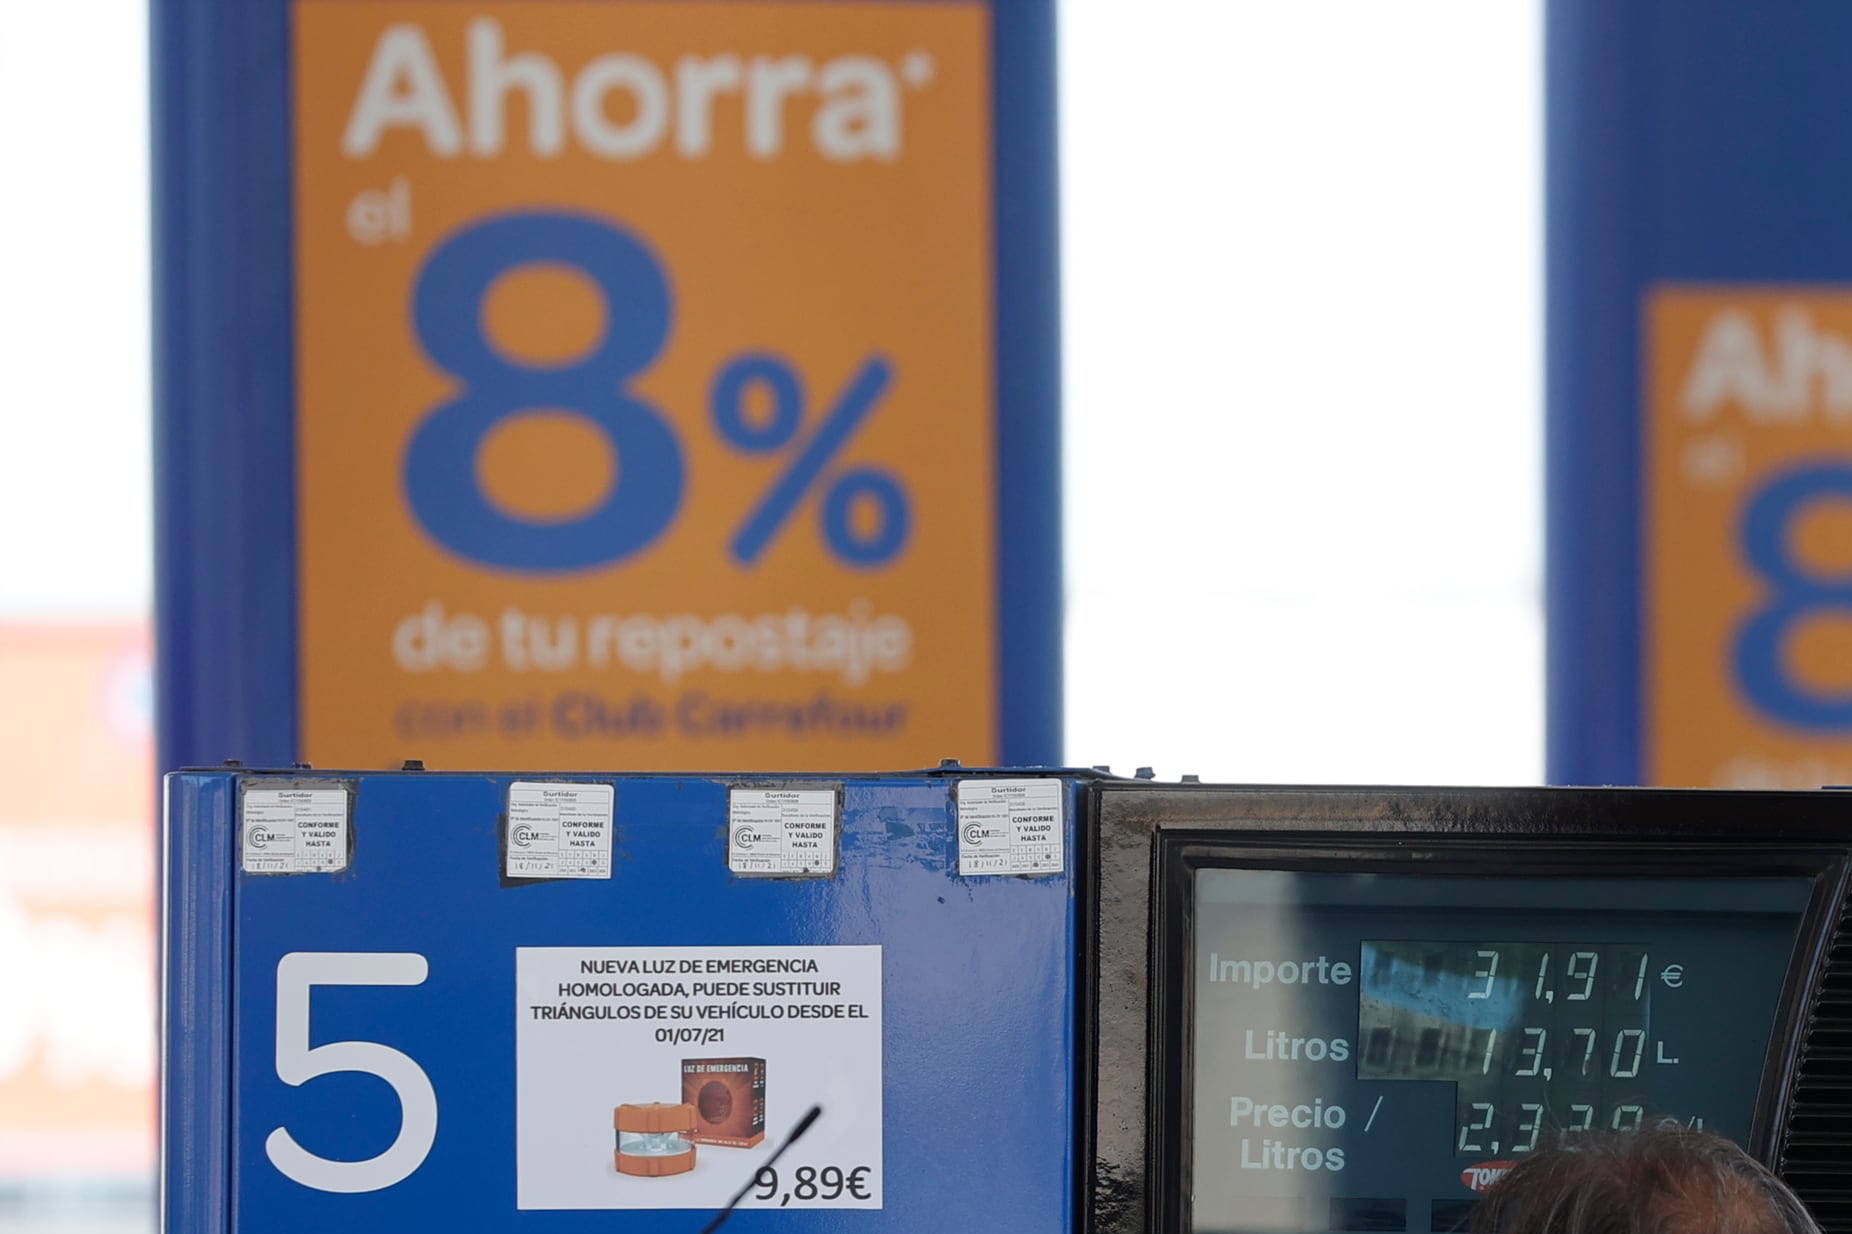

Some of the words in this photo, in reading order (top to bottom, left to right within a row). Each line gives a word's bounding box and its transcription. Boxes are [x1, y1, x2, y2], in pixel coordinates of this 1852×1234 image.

[346, 178, 412, 244] el
[392, 600, 489, 672] de
[501, 605, 579, 672] tu
[589, 598, 913, 688] repostaje
[552, 690, 664, 740] Club
[676, 690, 908, 741] Carrefour
[297, 821, 340, 829] CONFORME
[562, 821, 604, 829] CONFORME
[1012, 815, 1055, 824] CONFORME
[1023, 824, 1052, 832] VALIDO
[255, 833, 276, 842] CLM
[519, 832, 540, 841] CLM
[741, 834, 761, 842] CLM
[970, 829, 990, 838] CLM
[580, 959, 640, 974] NUEVA
[643, 959, 676, 974] LUZ
[679, 959, 703, 974] DE
[706, 959, 819, 974] EMERGENCIA
[1209, 952, 1352, 990] Importe
[1467, 950, 1649, 1004] 31,91
[1660, 963, 1684, 988] €
[558, 982, 690, 1000] HOMOLOGADA,
[693, 981, 750, 997] PUEDE
[753, 981, 841, 997] SUSTITUIR
[530, 1001, 641, 1020] TRIÁNGULOS
[644, 1005, 667, 1019] DE
[670, 1005, 693, 1019] SU
[696, 1000, 784, 1019] VEHÍCULO
[788, 1004, 844, 1019] DESDE
[849, 1004, 869, 1019] EL
[655, 1027, 725, 1046] 01/07/21
[1245, 1029, 1350, 1062] Litros
[1482, 1027, 1646, 1081] 13,70
[265, 951, 439, 1194] 5
[683, 1064, 695, 1073] LUZ
[696, 1064, 705, 1073] DE
[706, 1063, 749, 1073] EMERGENCIA
[1230, 1096, 1346, 1129] Precio
[1240, 1138, 1346, 1171] Litros
[755, 1165, 872, 1207] 9,89€
